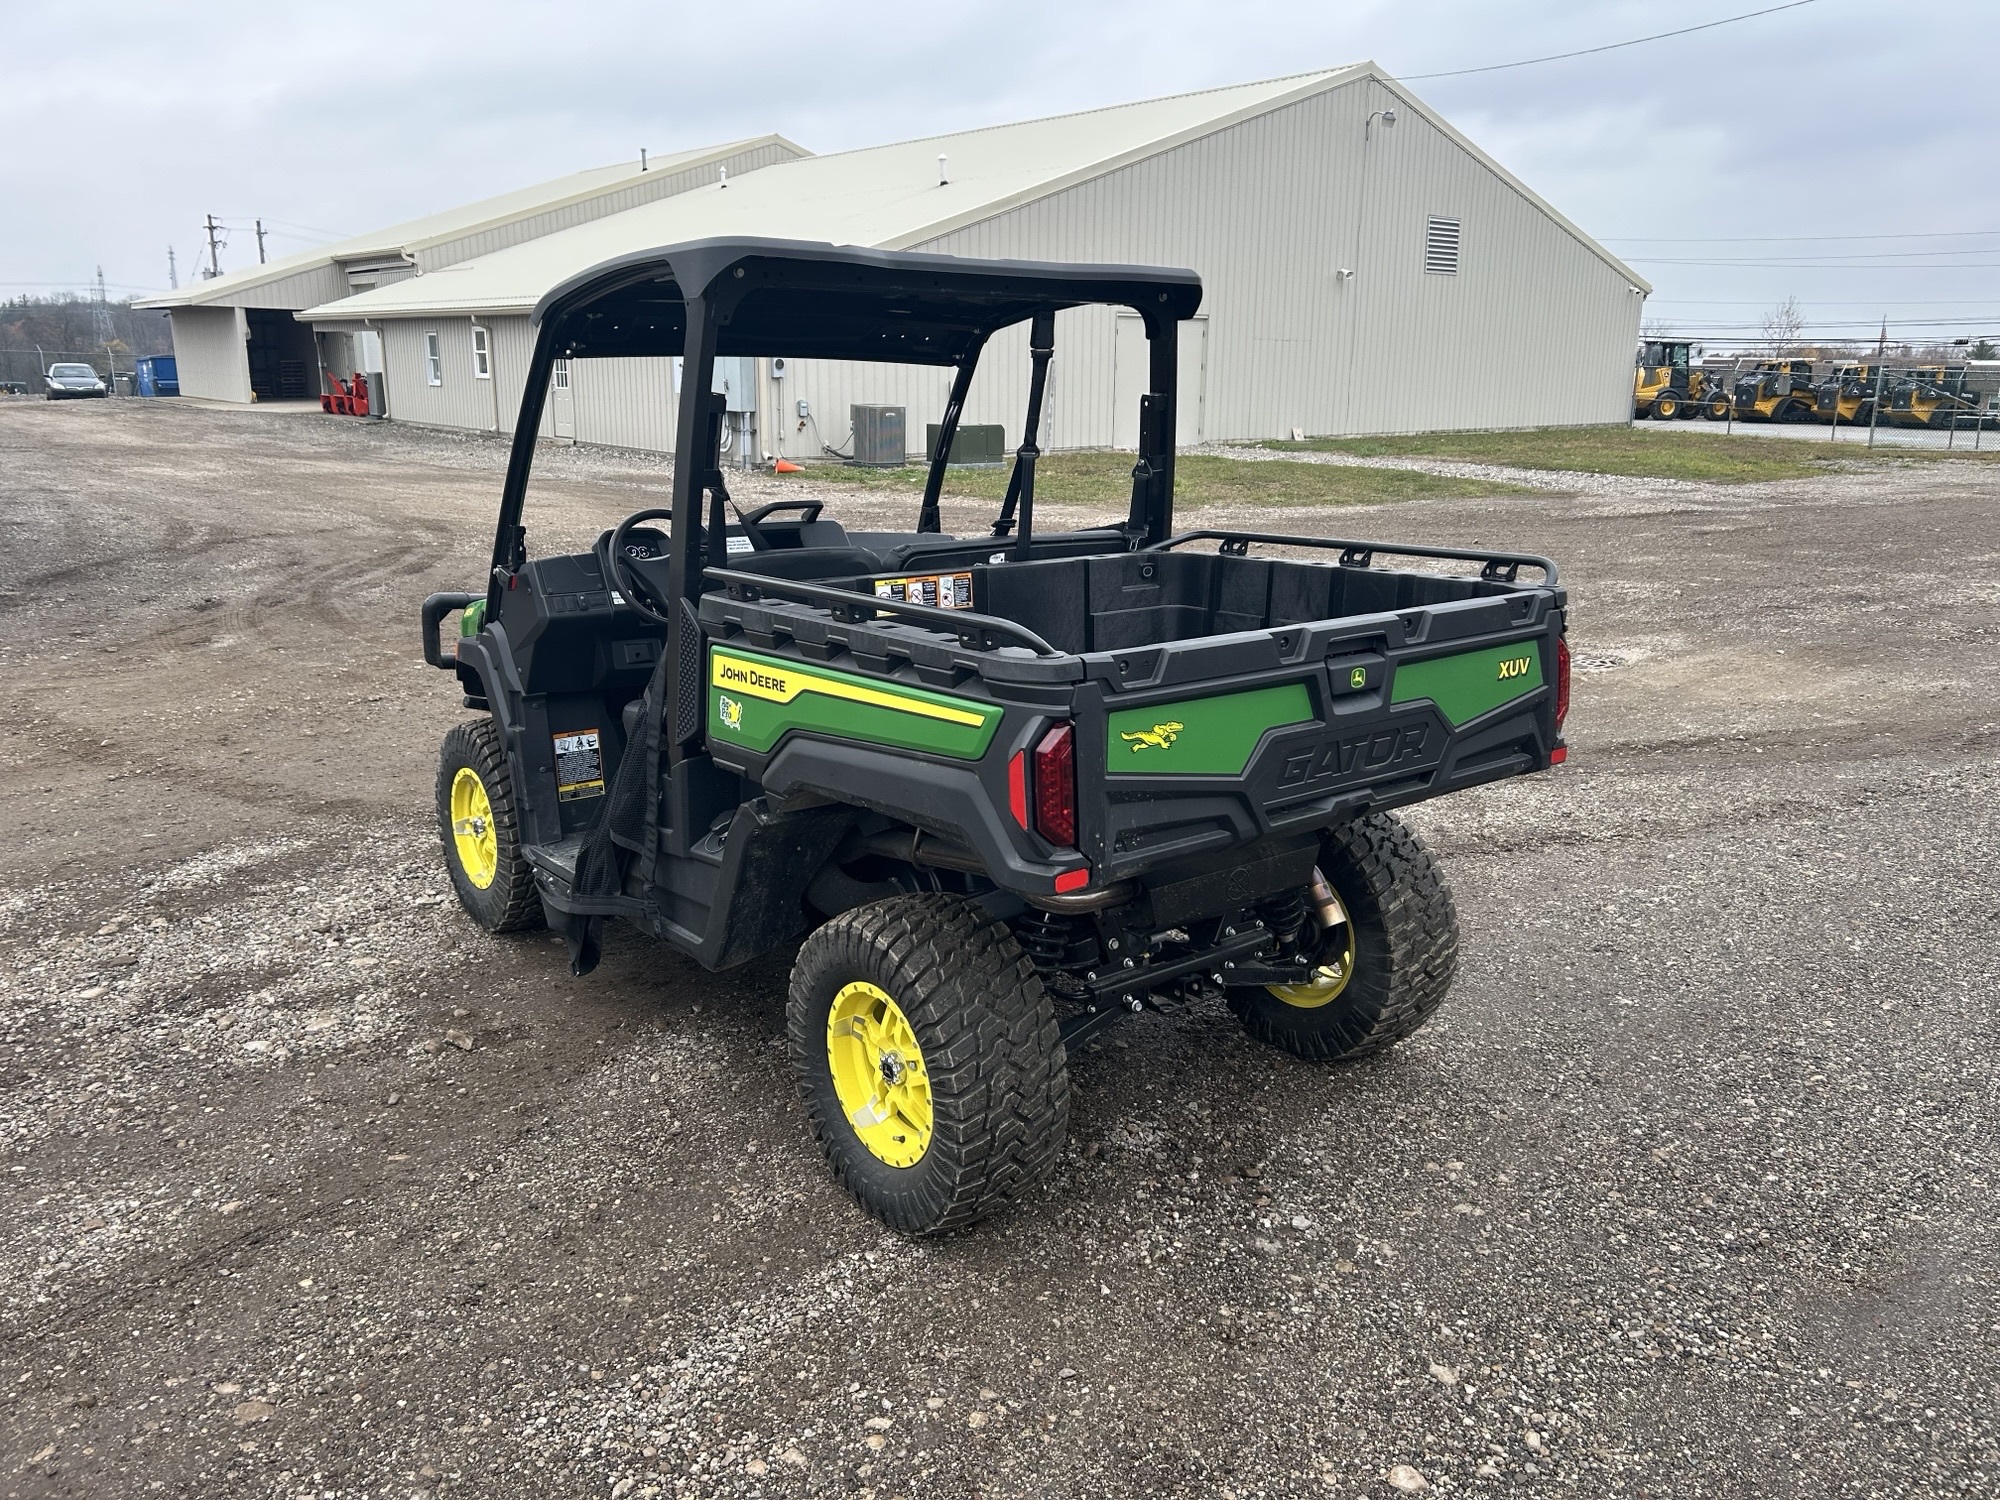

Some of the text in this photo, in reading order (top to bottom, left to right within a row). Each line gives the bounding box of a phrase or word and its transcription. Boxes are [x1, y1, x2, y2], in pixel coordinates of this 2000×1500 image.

[720, 664, 786, 693] JOHN DEERE
[1498, 657, 1531, 680] XUV
[1277, 721, 1429, 789] GATOR
